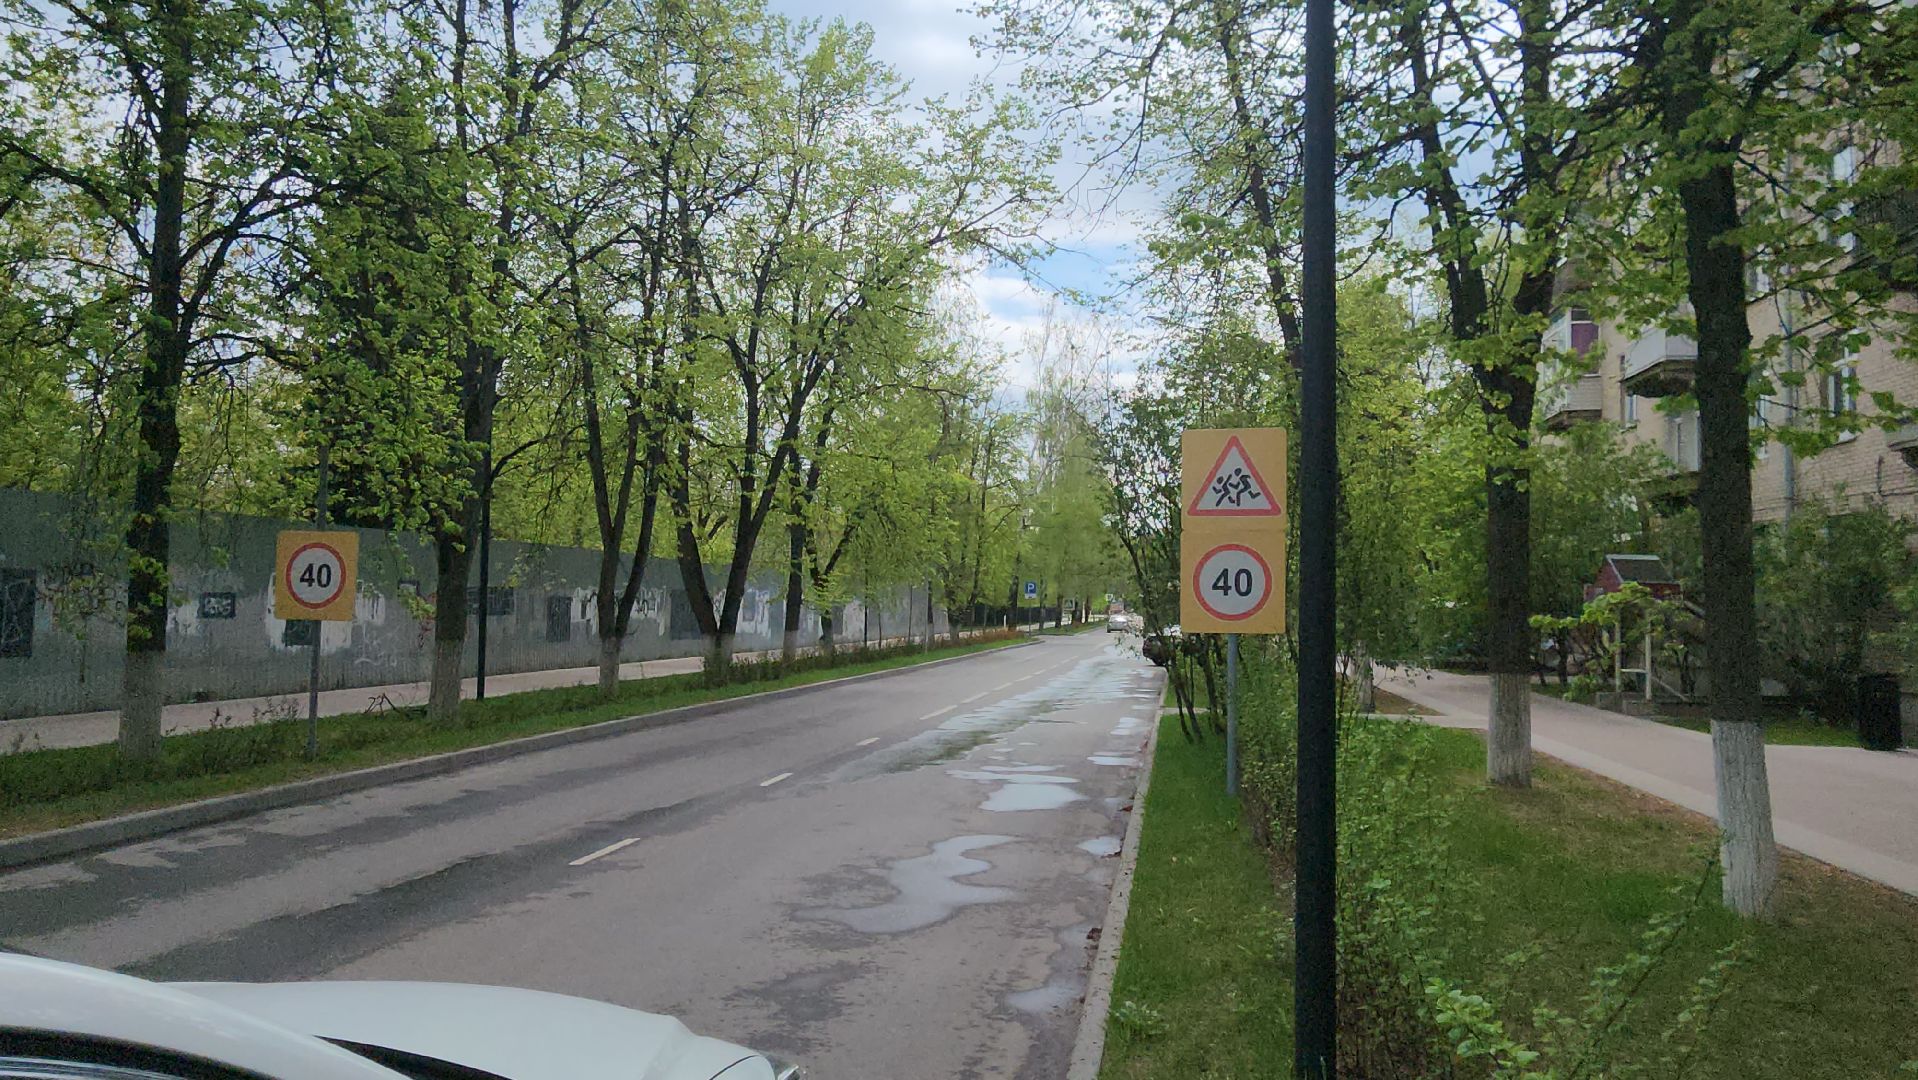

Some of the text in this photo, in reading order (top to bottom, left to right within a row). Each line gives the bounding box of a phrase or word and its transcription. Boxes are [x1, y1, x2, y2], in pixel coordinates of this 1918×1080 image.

[299, 563, 332, 588] 40
[1027, 583, 1035, 593] P
[1211, 568, 1253, 597] 40
